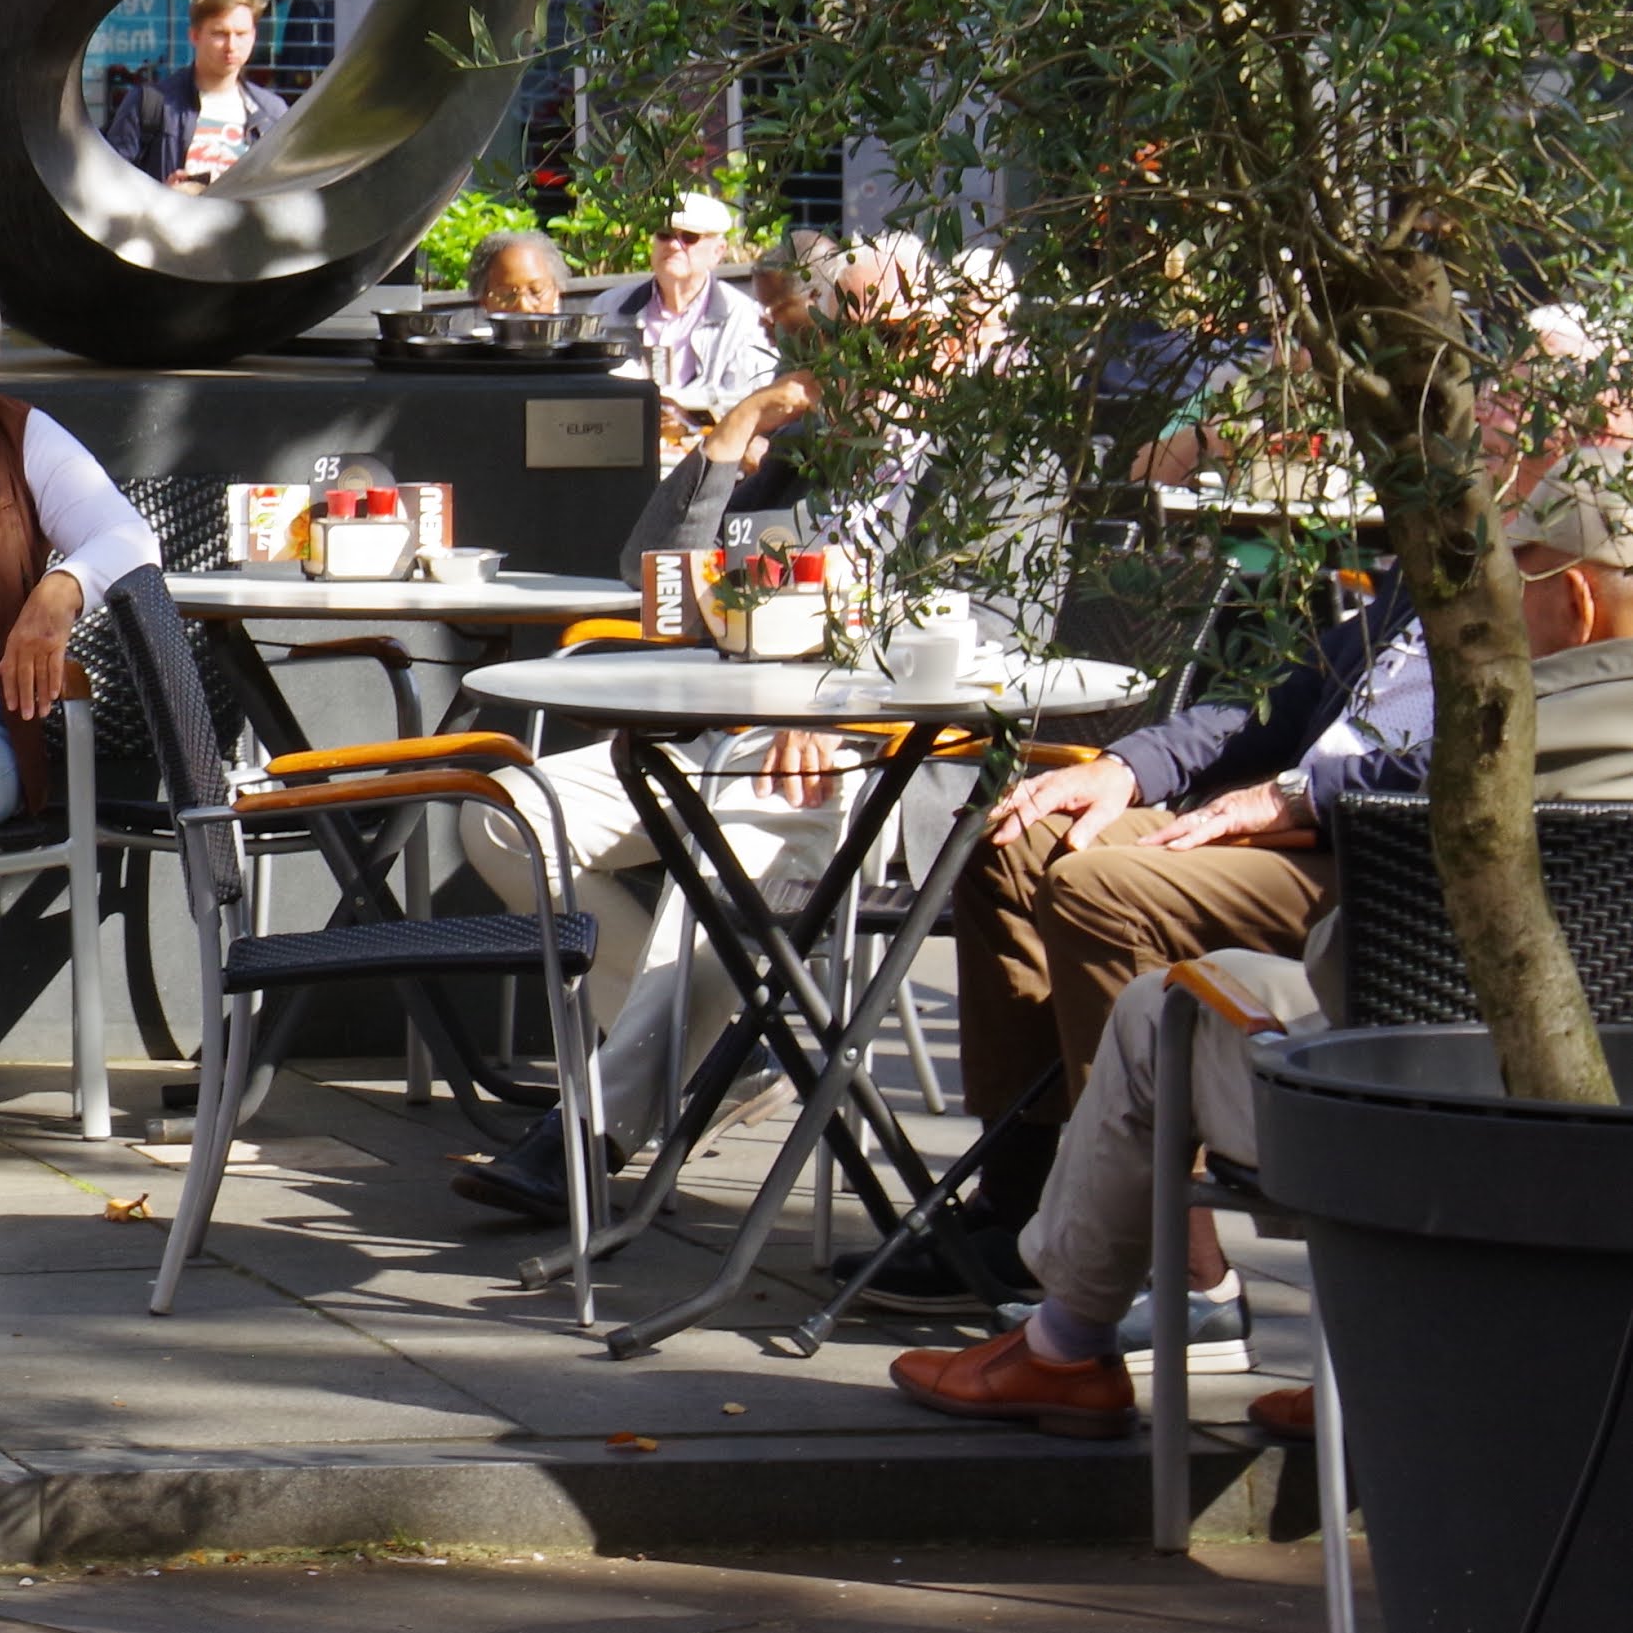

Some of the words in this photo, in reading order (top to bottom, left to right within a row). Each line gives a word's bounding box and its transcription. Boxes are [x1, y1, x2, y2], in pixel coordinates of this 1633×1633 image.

[313, 456, 341, 483] 93
[728, 517, 753, 547] 92
[655, 554, 683, 636] MENU
